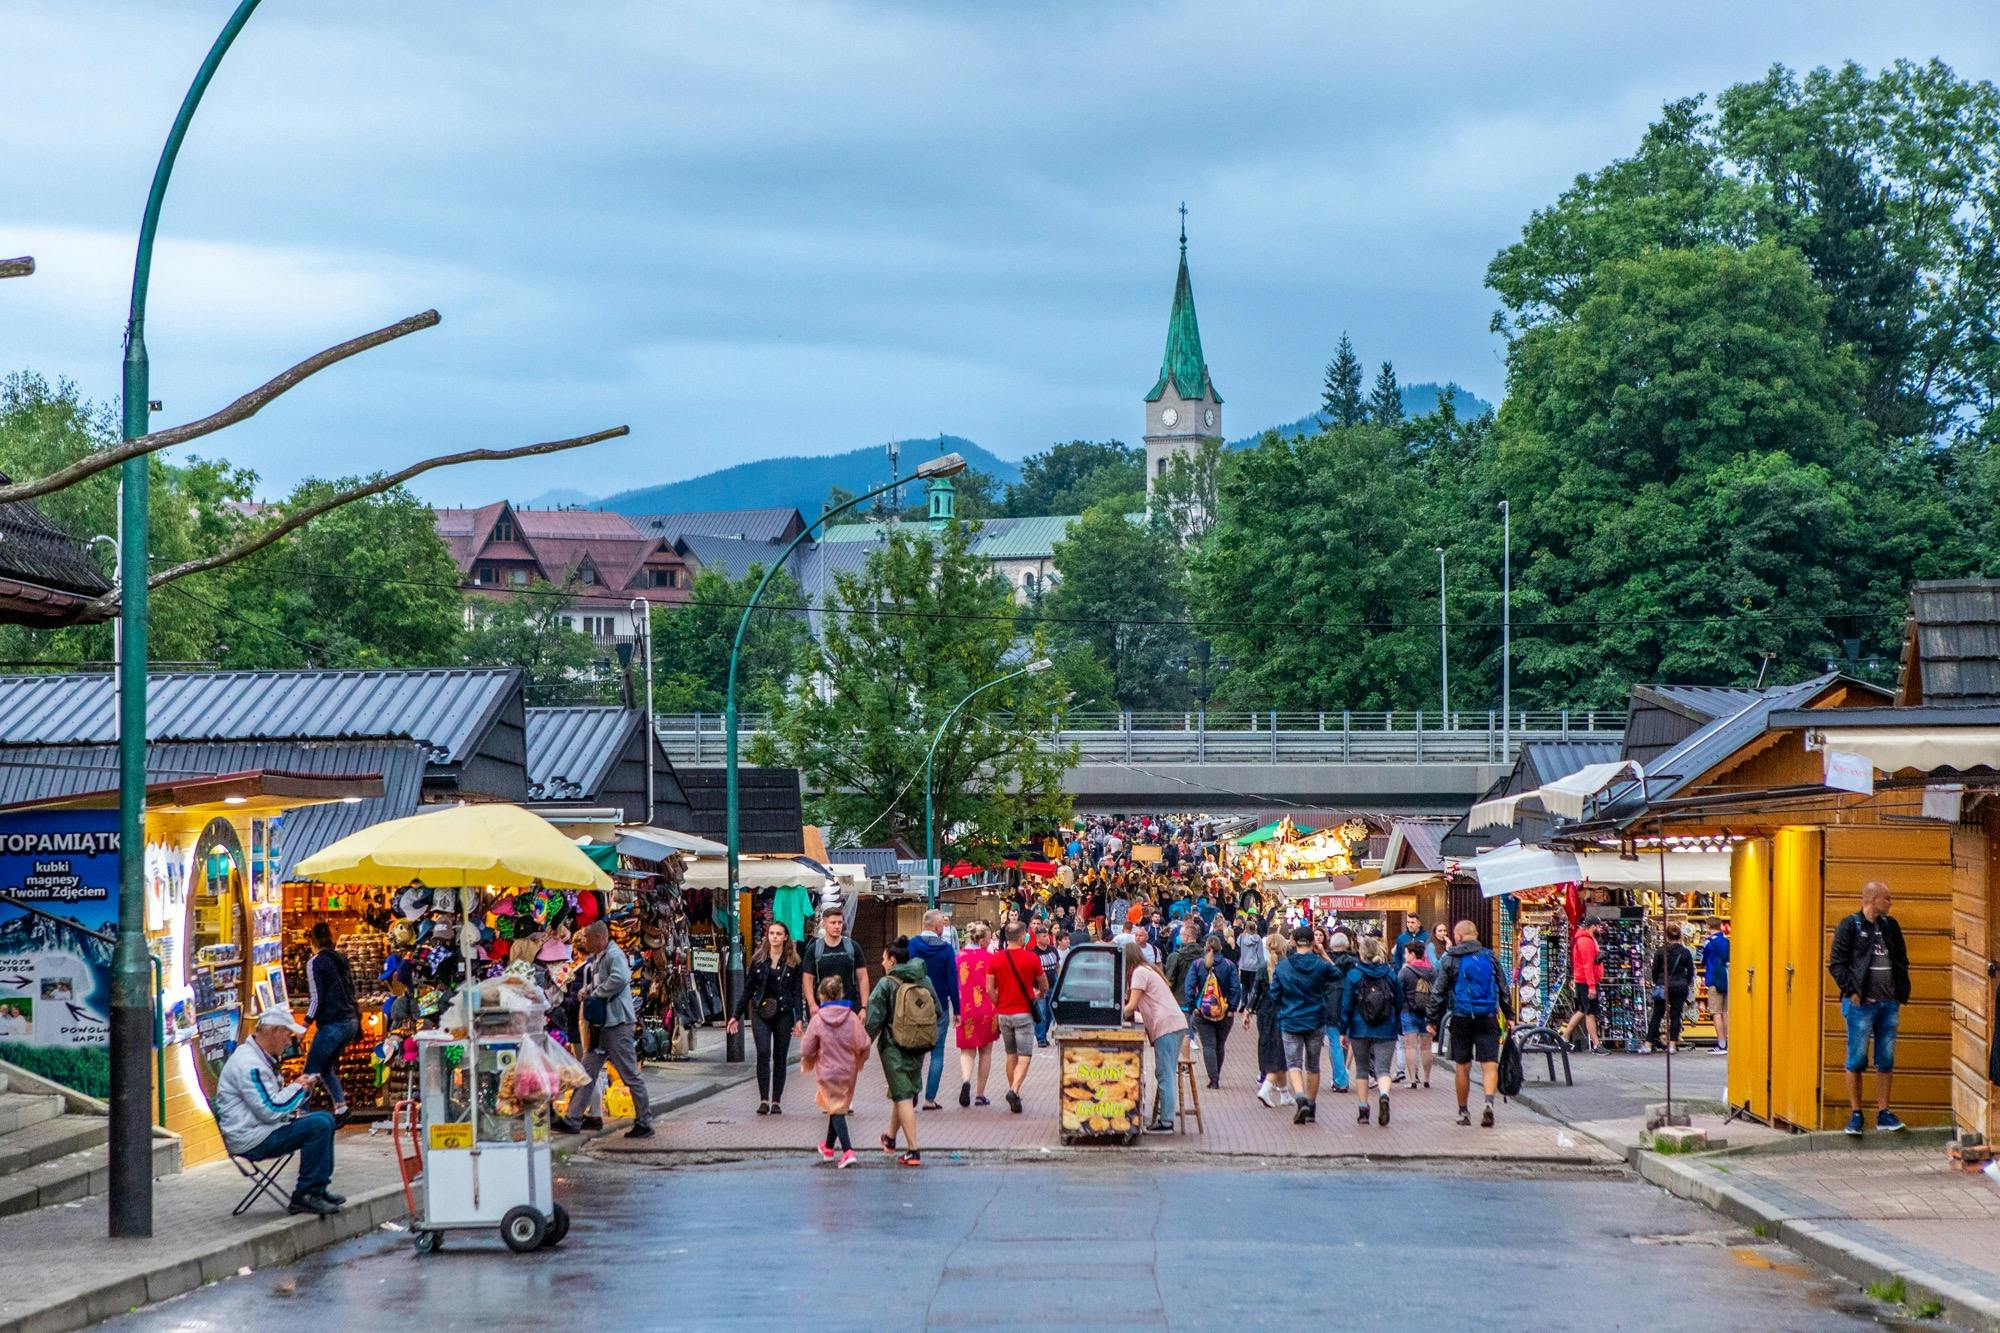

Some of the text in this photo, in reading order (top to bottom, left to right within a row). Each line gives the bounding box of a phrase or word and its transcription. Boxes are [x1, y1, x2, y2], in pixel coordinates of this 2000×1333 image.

[35, 861, 69, 872] kubki
[26, 876, 79, 887] magnesy
[9, 887, 49, 898] Twoim
[52, 886, 106, 899] Zdjęciem
[72, 1035, 105, 1043] NAPIS
